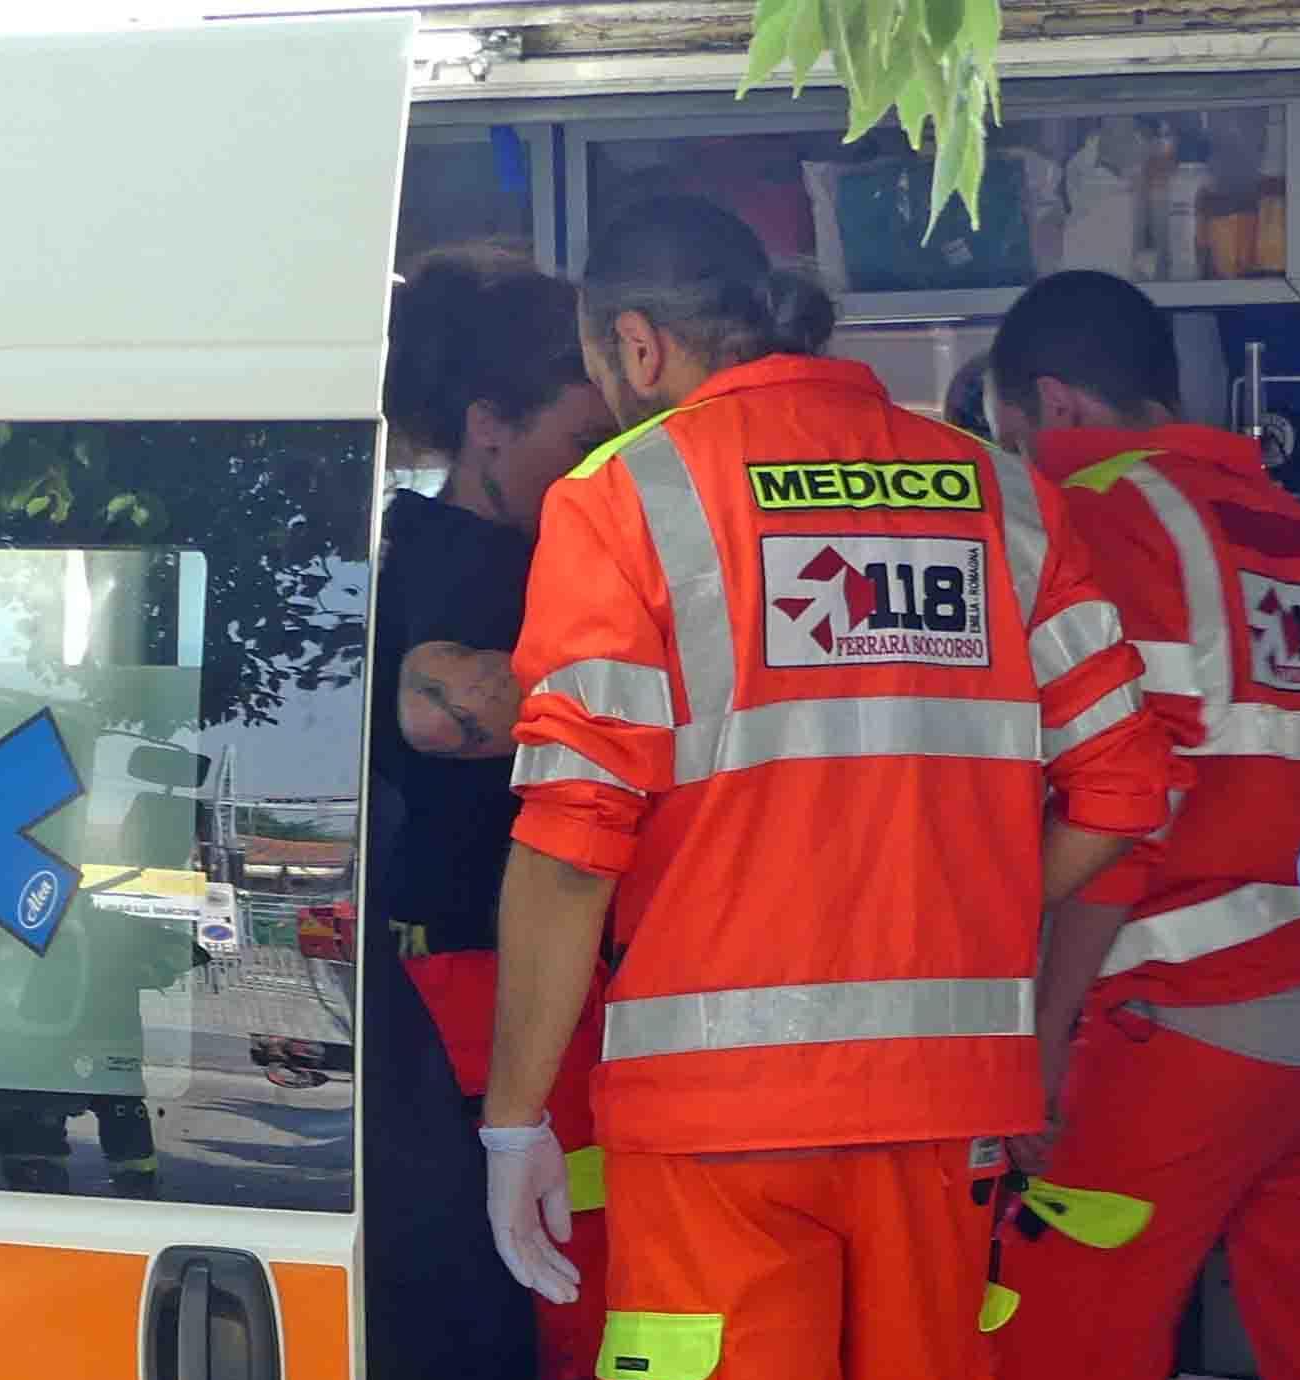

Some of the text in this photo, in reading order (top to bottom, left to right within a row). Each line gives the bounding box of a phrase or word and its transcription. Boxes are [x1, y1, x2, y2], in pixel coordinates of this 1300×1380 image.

[756, 469, 971, 501] MEDICO
[863, 562, 967, 632] 118
[837, 635, 983, 658] FERRARA SOCCORSO
